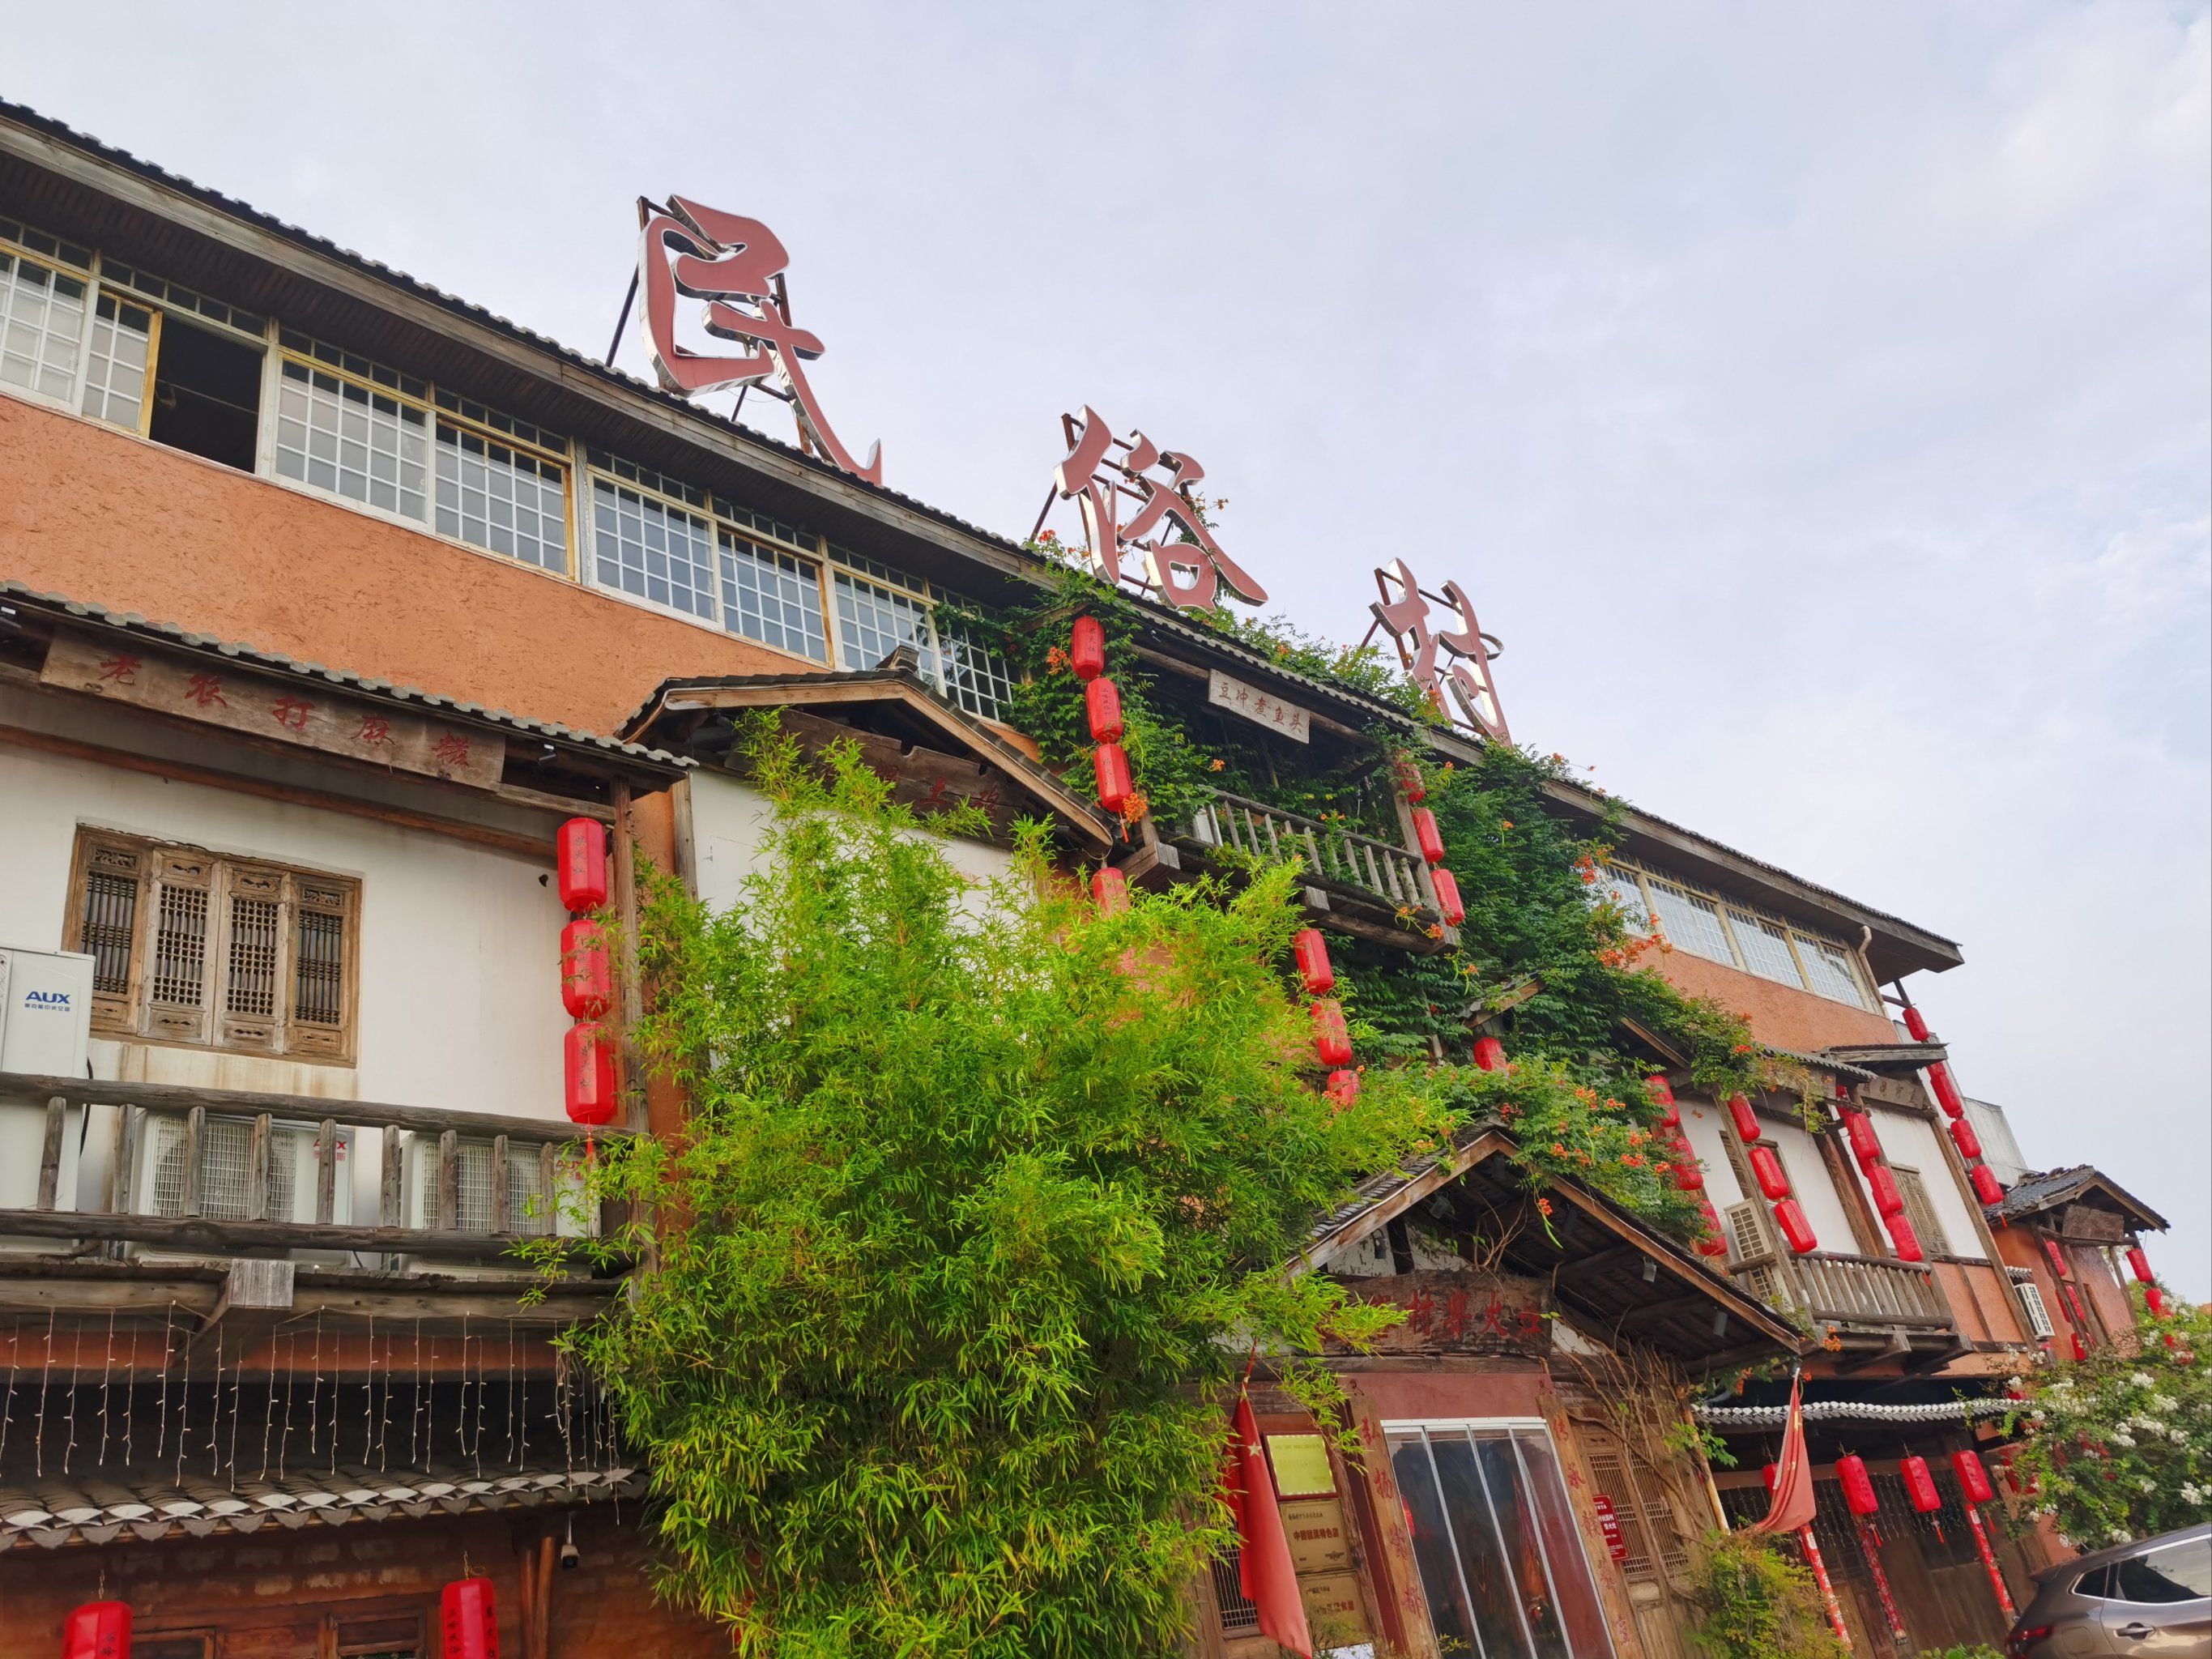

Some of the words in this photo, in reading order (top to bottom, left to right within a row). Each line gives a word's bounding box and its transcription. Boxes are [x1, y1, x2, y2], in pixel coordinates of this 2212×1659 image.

[639, 194, 1510, 745] 民俗村
[26, 991, 70, 1004] AUX
